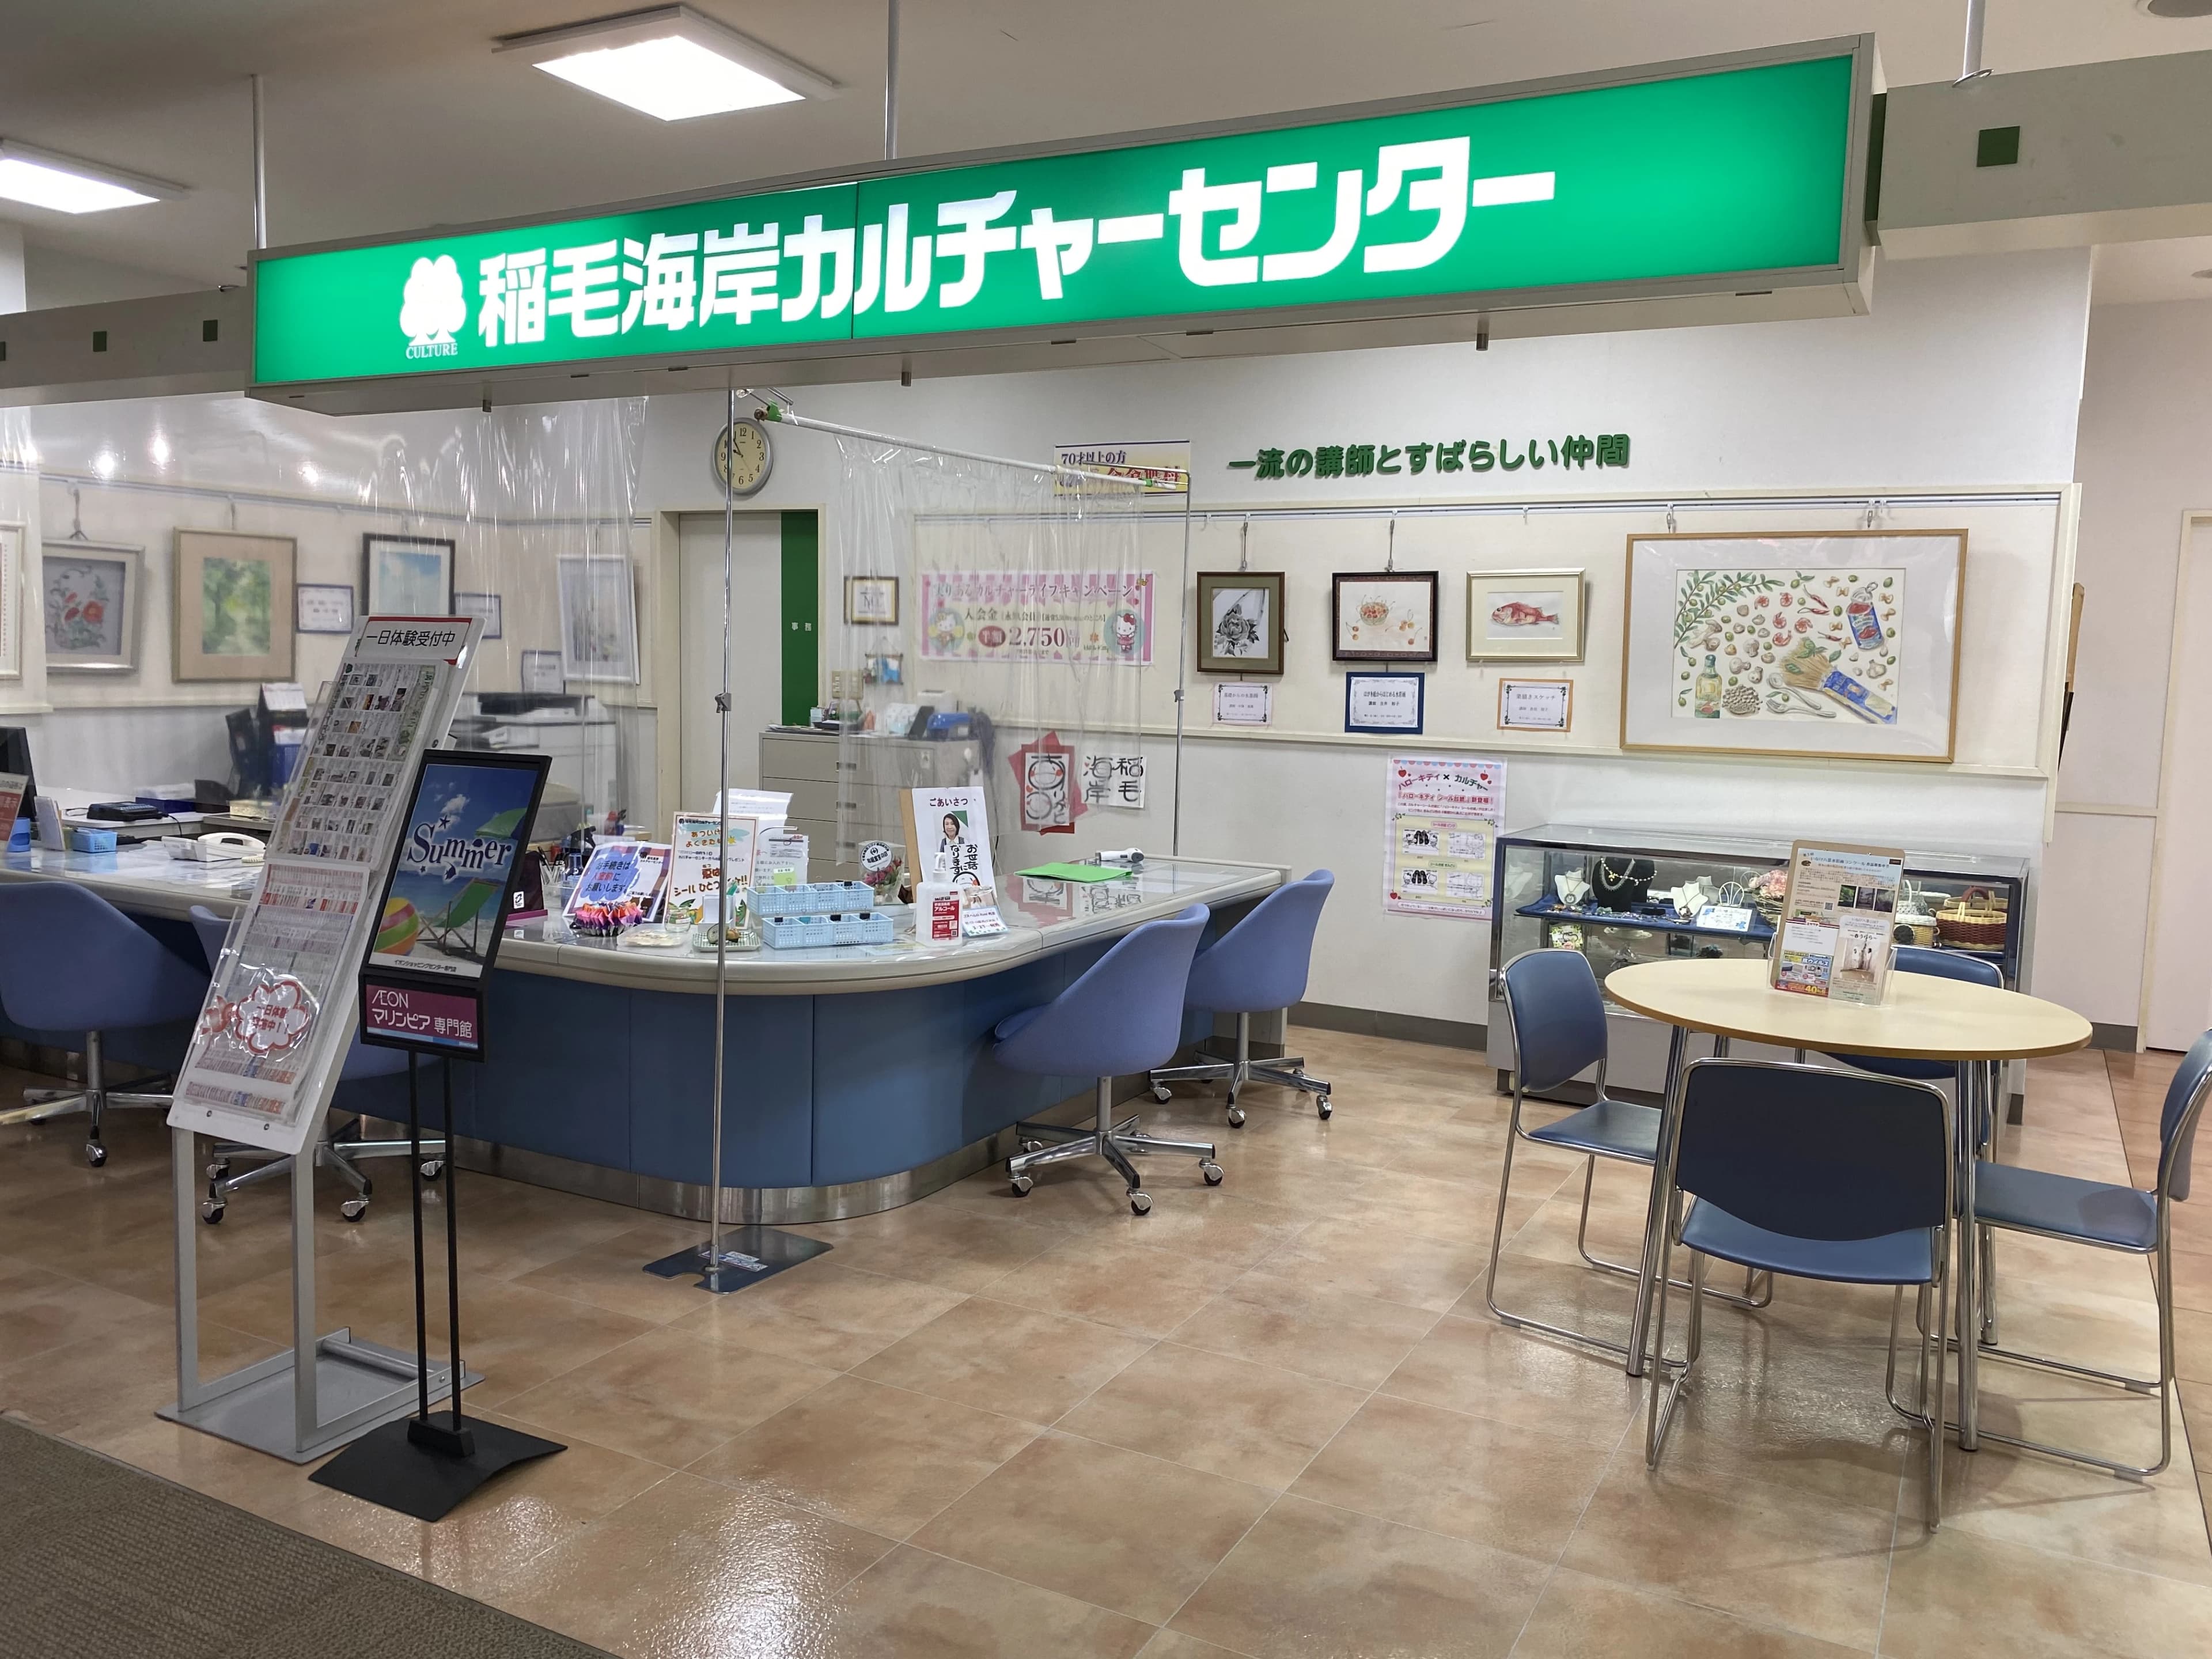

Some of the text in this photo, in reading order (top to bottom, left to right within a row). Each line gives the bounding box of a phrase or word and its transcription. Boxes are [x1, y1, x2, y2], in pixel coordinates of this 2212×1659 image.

[479, 136, 1555, 348] 稲毛海岸カルチャーセンター
[406, 343, 458, 359] CULTURE
[740, 427, 747, 437] 12
[757, 440, 762, 449] 2
[721, 452, 726, 461] 9
[759, 452, 764, 461] 3
[1061, 450, 1127, 465] 70才以上の方
[1229, 434, 1630, 478] 一流の講師とすばらしい仲間
[755, 464, 760, 472] 4
[738, 476, 744, 484] 6
[748, 474, 753, 482] 5
[366, 629, 456, 647] 一日体験受付中
[1117, 756, 1143, 802] 稲毛
[1398, 774, 1440, 790] ハローキティ
[1455, 774, 1488, 791] カルチャー
[930, 797, 968, 806] ごあいさつ
[691, 828, 721, 838] あついけ
[406, 823, 513, 869] Summer
[596, 861, 631, 870] お手続きは
[949, 844, 961, 874] なります
[674, 885, 696, 897] シール
[699, 881, 720, 891] ひとつ
[372, 1008, 472, 1039] マリンピア 専門館
